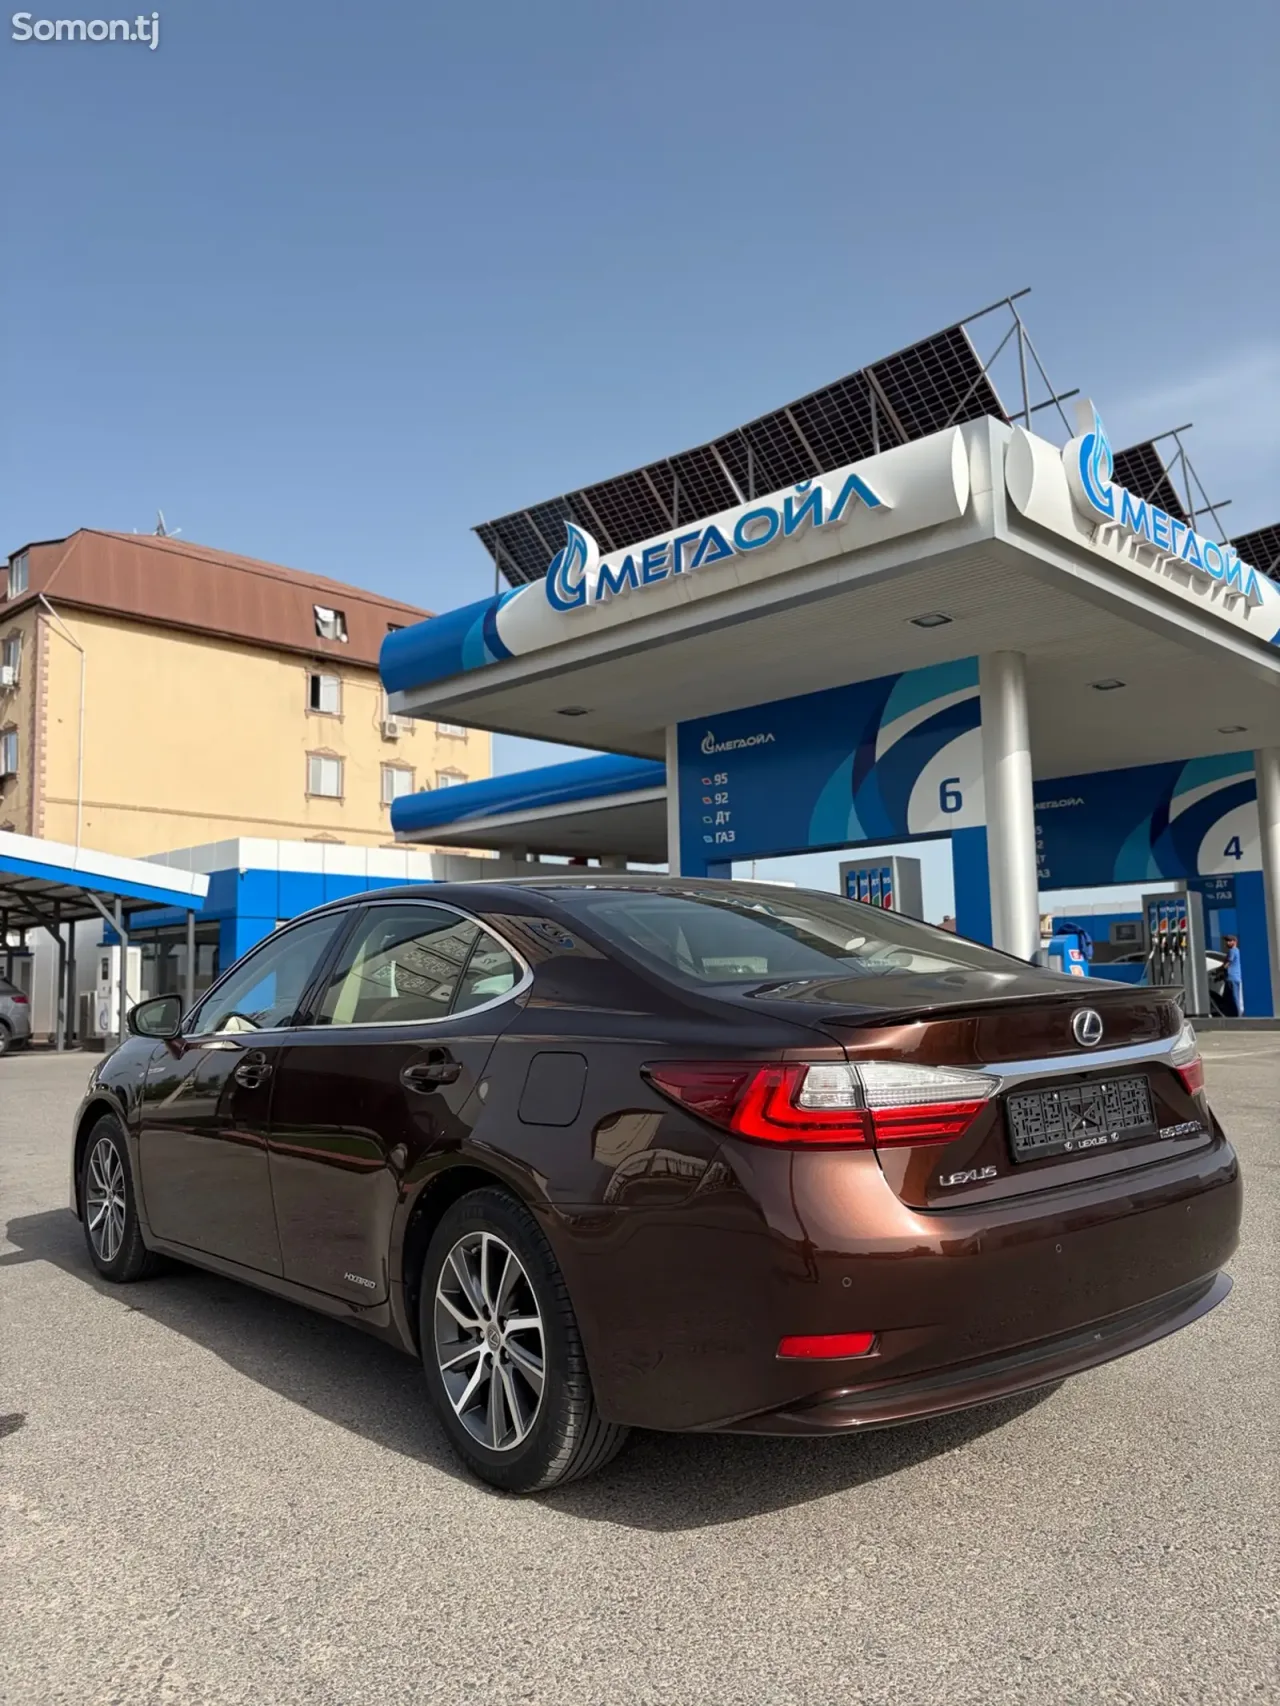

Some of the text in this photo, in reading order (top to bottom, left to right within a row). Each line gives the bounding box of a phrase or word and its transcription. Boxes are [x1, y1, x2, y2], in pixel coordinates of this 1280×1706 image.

[714, 772, 728, 785] 95
[714, 792, 729, 804] 92
[939, 777, 963, 813] 6
[715, 810, 731, 825] ДТ
[715, 831, 736, 844] ГАЗ
[1223, 836, 1244, 860] 4
[1216, 891, 1232, 900] ГАЗ
[1078, 1136, 1108, 1148] LEXUS
[939, 1165, 997, 1187] LEXUS
[343, 1272, 376, 1289] HYBRID
